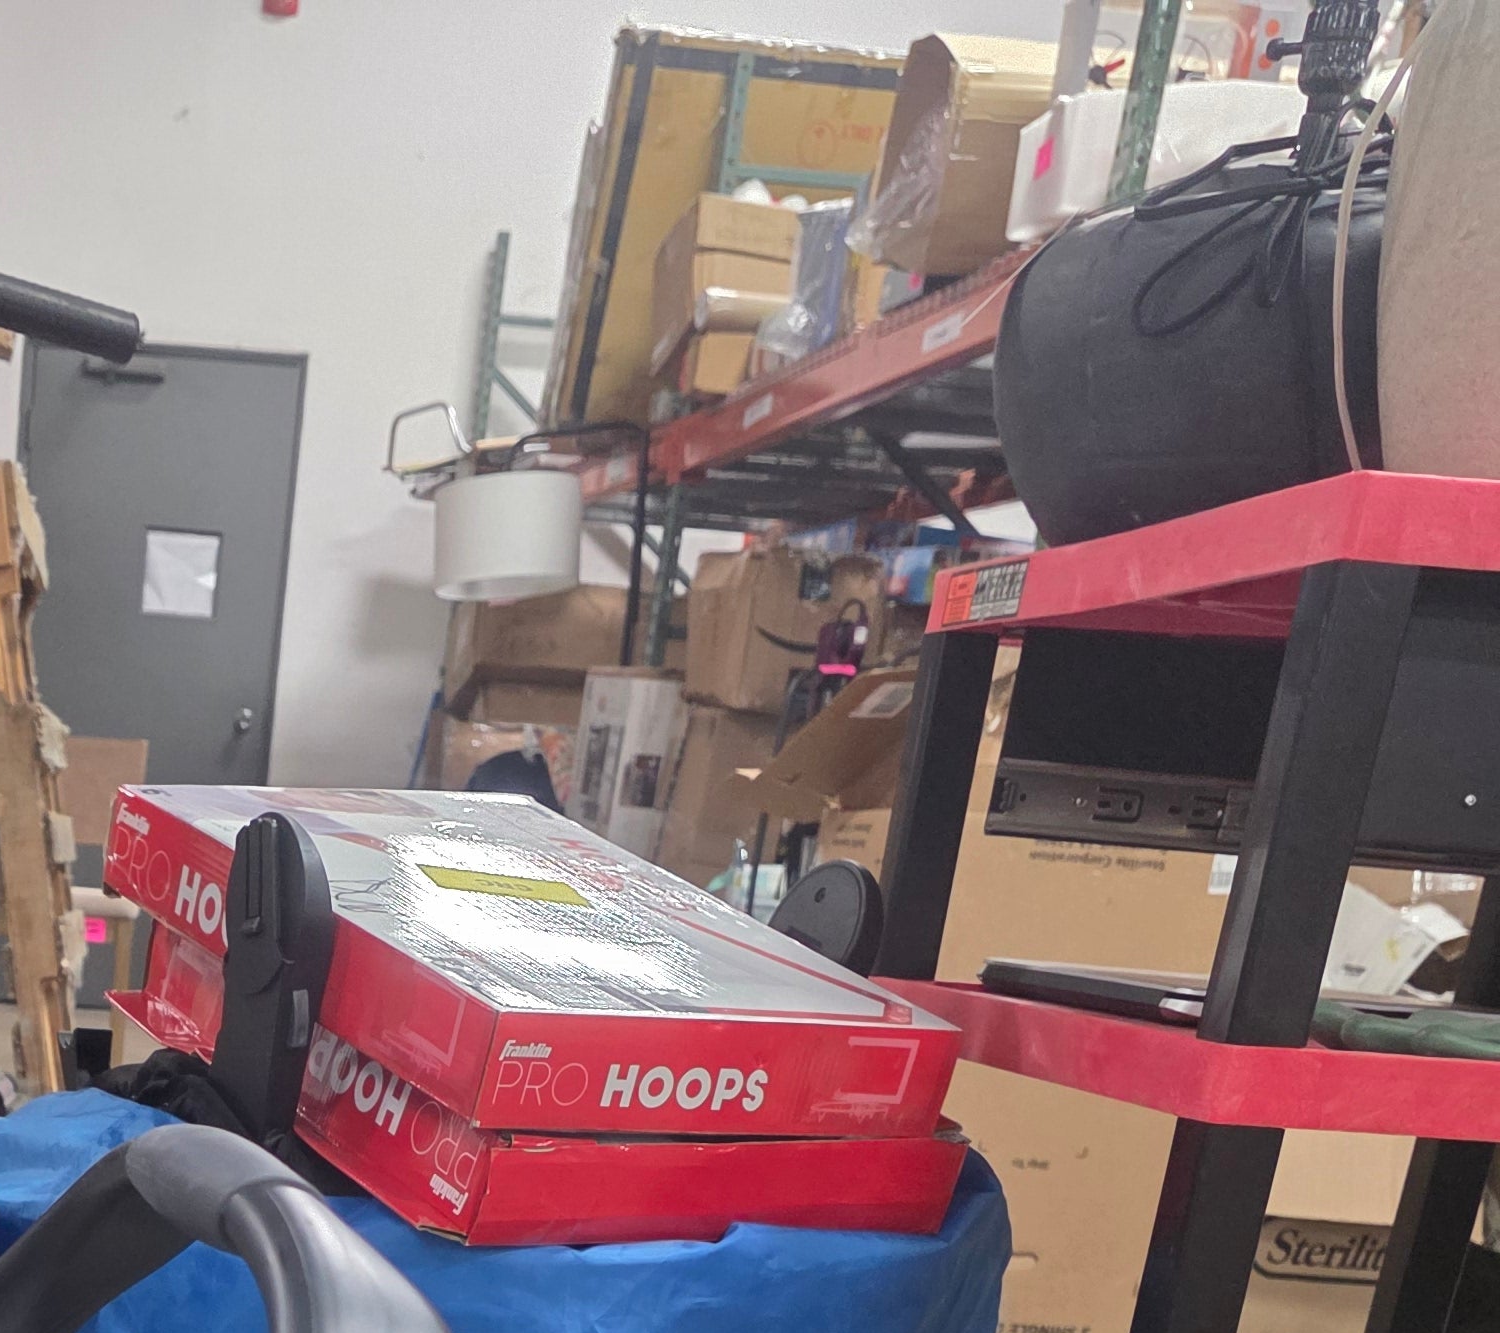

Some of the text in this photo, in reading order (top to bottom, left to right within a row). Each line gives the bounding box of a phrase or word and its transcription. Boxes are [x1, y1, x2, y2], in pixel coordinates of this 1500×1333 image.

[110, 827, 227, 949] PRO HO
[499, 1039, 551, 1061] franklin
[492, 1061, 768, 1112] PRO HOOPS
[411, 1100, 479, 1190] PRO
